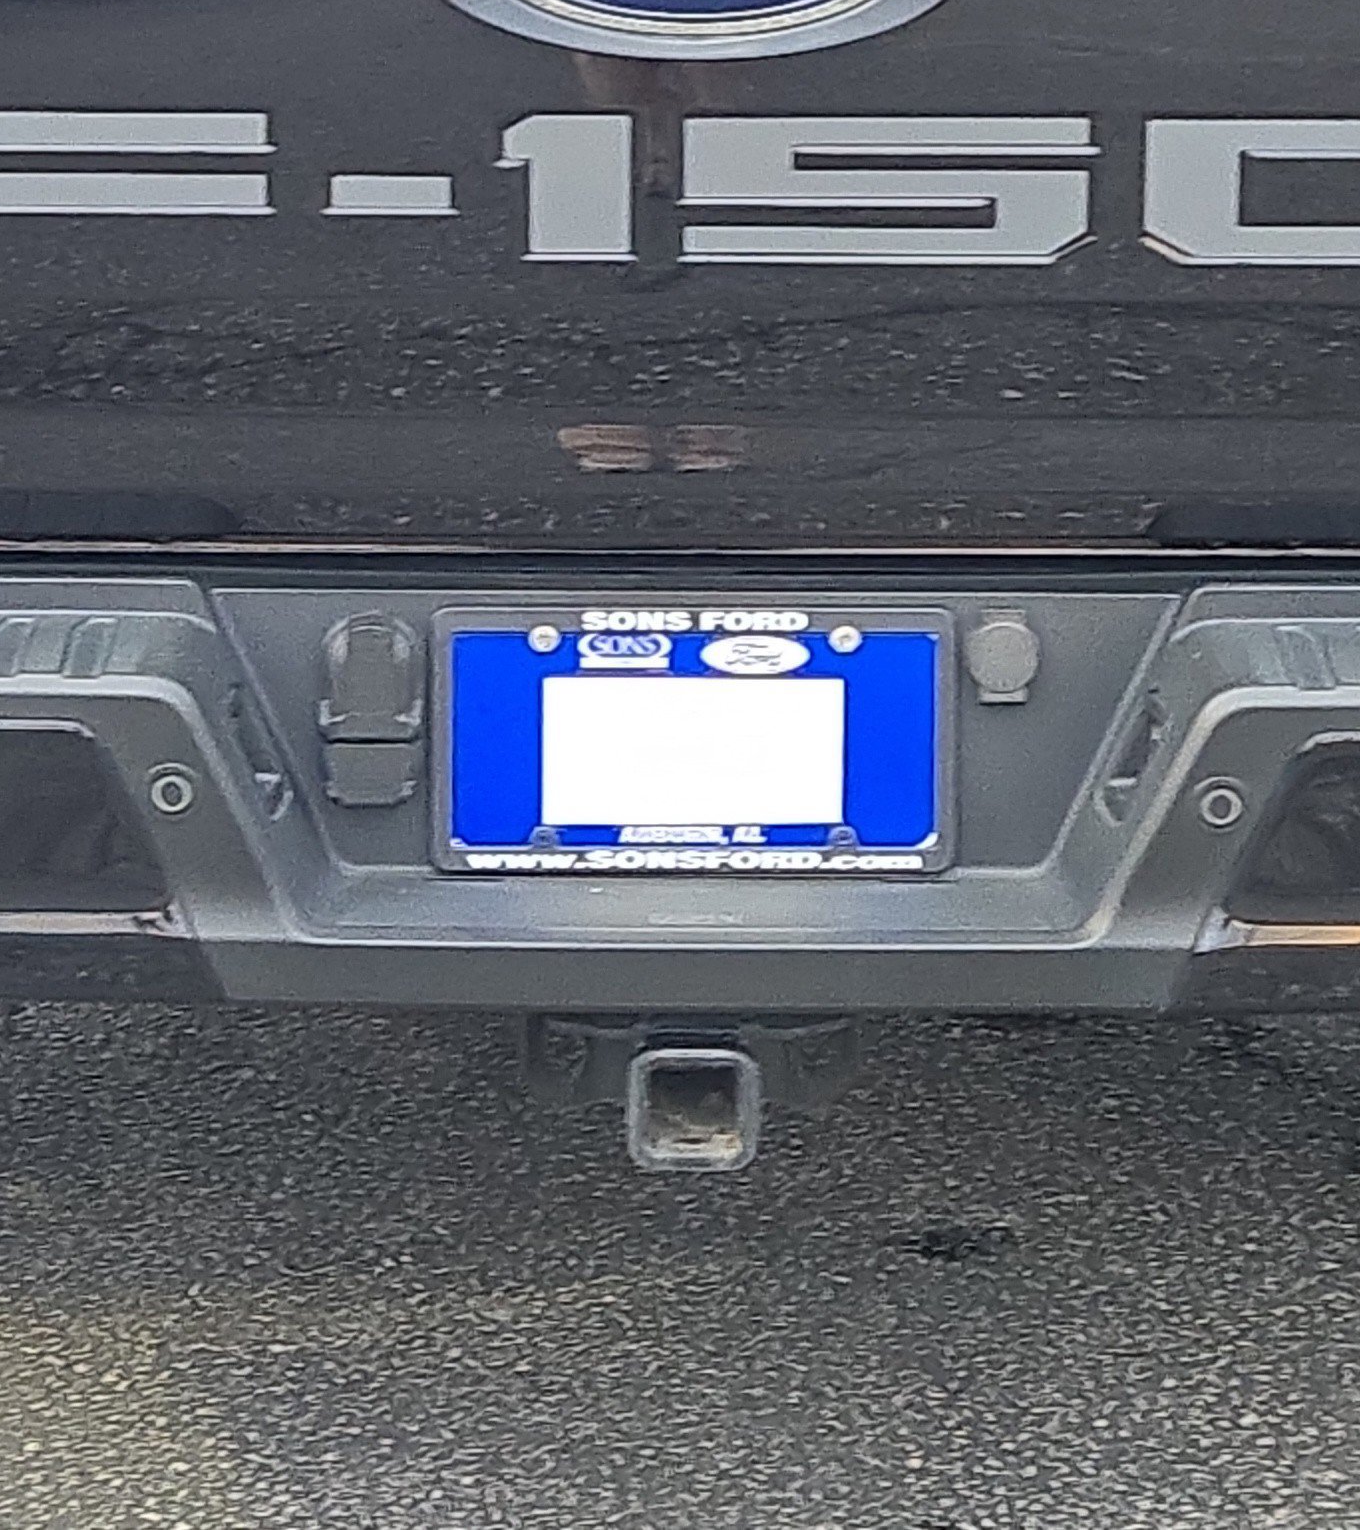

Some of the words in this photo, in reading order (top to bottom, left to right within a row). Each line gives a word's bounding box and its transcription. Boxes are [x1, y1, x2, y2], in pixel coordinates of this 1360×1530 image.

[581, 611, 692, 631] SONS
[699, 611, 809, 631] FORD
[591, 634, 659, 655] SONS
[467, 850, 925, 870] www.SONSFORD.com
